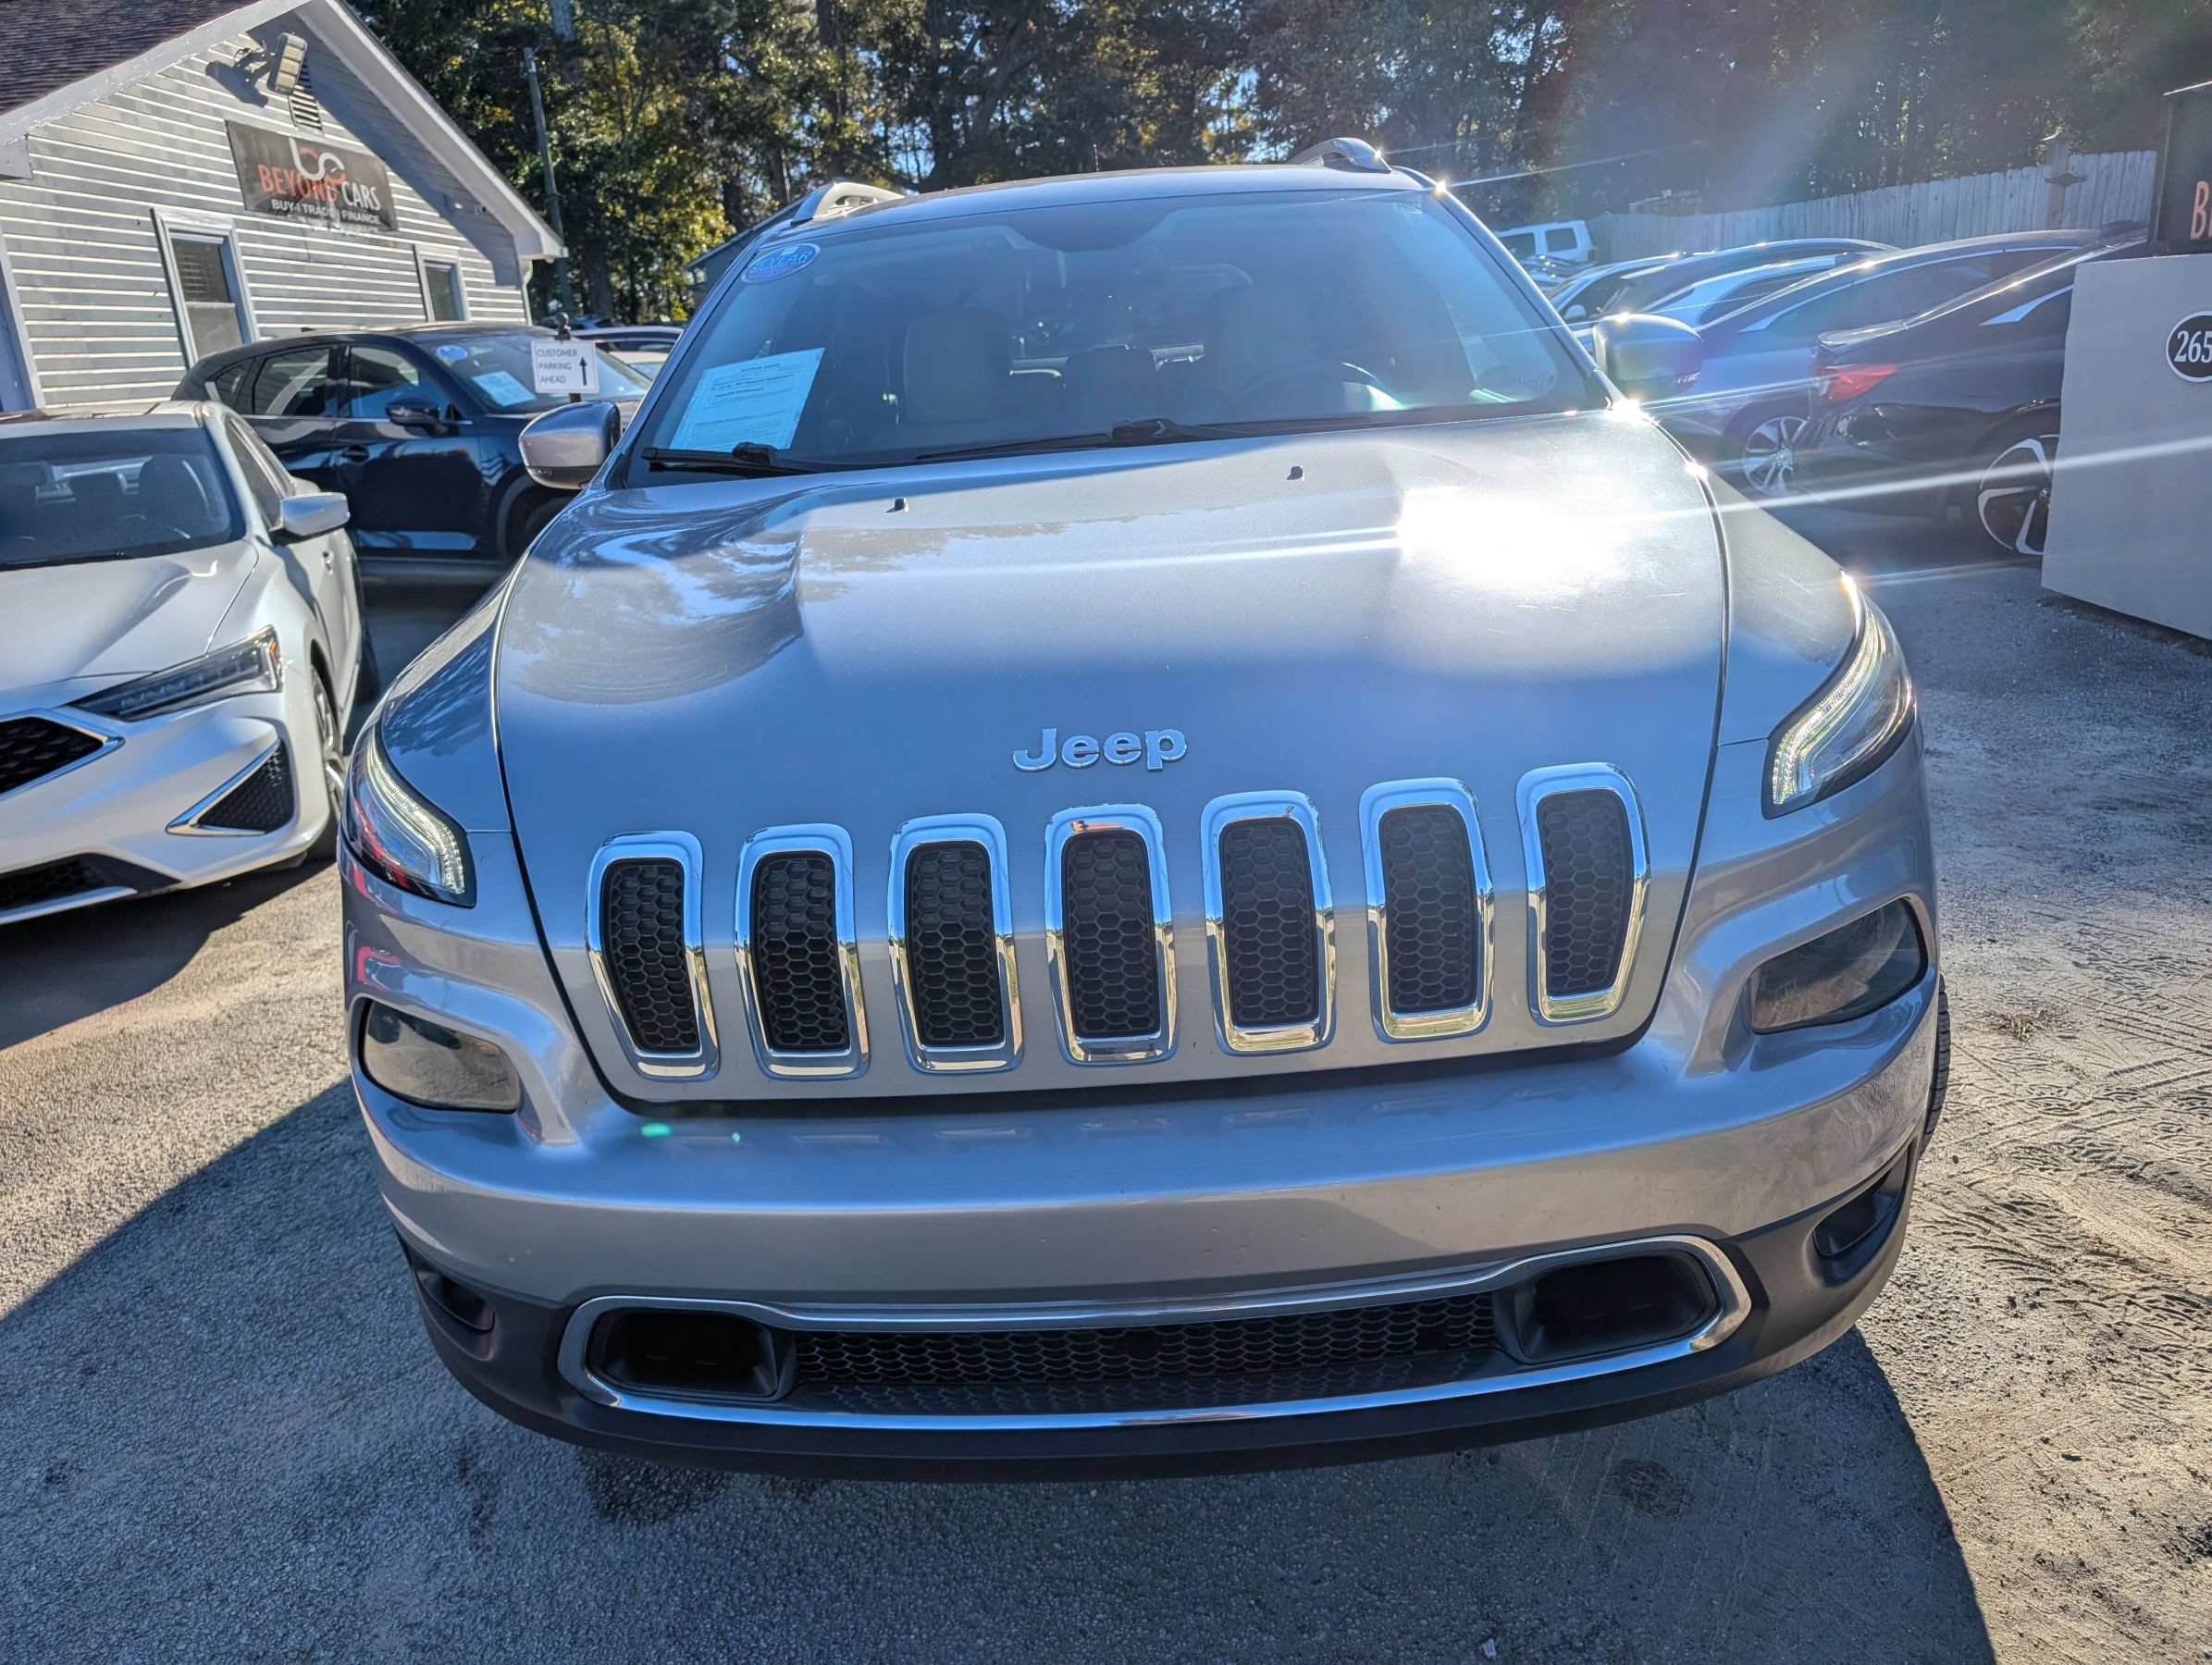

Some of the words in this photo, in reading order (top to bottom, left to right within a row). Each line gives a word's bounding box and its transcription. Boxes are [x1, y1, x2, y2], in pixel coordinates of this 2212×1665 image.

[257, 164, 339, 202] BEYOND
[341, 180, 382, 211] CARS
[271, 199, 294, 212] BUY
[302, 203, 335, 218] TRADE
[341, 211, 381, 225] FINANCE
[2190, 180, 2212, 240] B
[537, 348, 578, 357] CUSTOMER
[2174, 329, 2212, 364] 265
[538, 362, 572, 371] PARKING
[539, 375, 566, 385] AHEAD
[1013, 727, 1187, 772] Jeep
